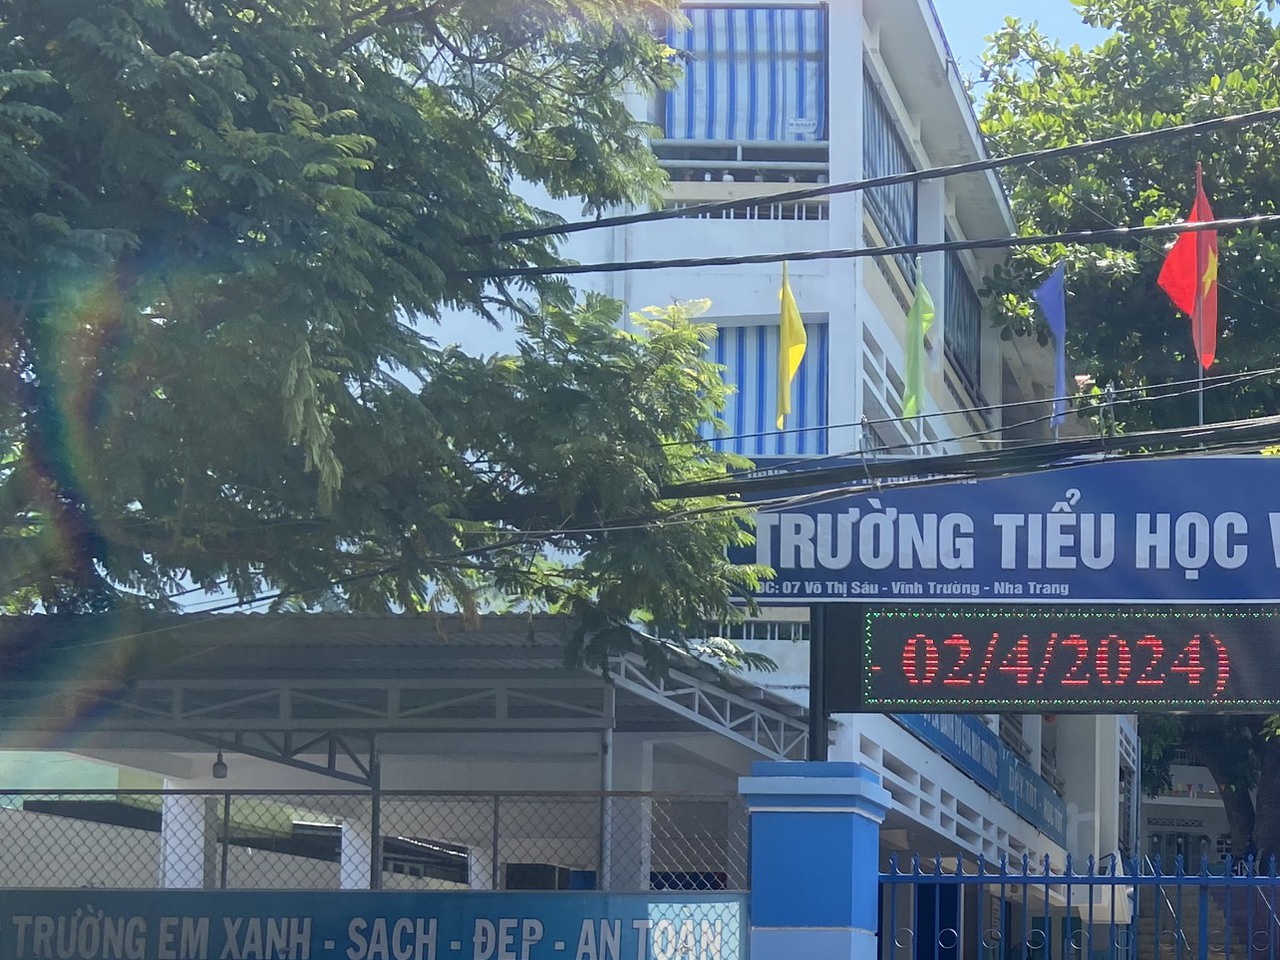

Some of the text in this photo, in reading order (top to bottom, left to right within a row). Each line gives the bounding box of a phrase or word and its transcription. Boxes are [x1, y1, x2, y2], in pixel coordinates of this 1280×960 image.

[756, 498, 975, 570] TRƯỜNG
[994, 488, 1115, 569] TIỂU
[1135, 511, 1248, 580] HỌC
[782, 581, 801, 594] 07
[805, 580, 823, 594] Võ
[826, 581, 847, 597] Thị
[851, 580, 879, 594] Sáu
[891, 580, 924, 594] Vĩnh
[928, 580, 980, 596] Trường
[994, 581, 1023, 594] Nha
[1028, 581, 1069, 596] Trang
[902, 632, 1230, 697] 02/4/2024)
[12, 904, 147, 960] TRƯỜNG
[158, 917, 209, 960] EM
[220, 917, 312, 960] XANH
